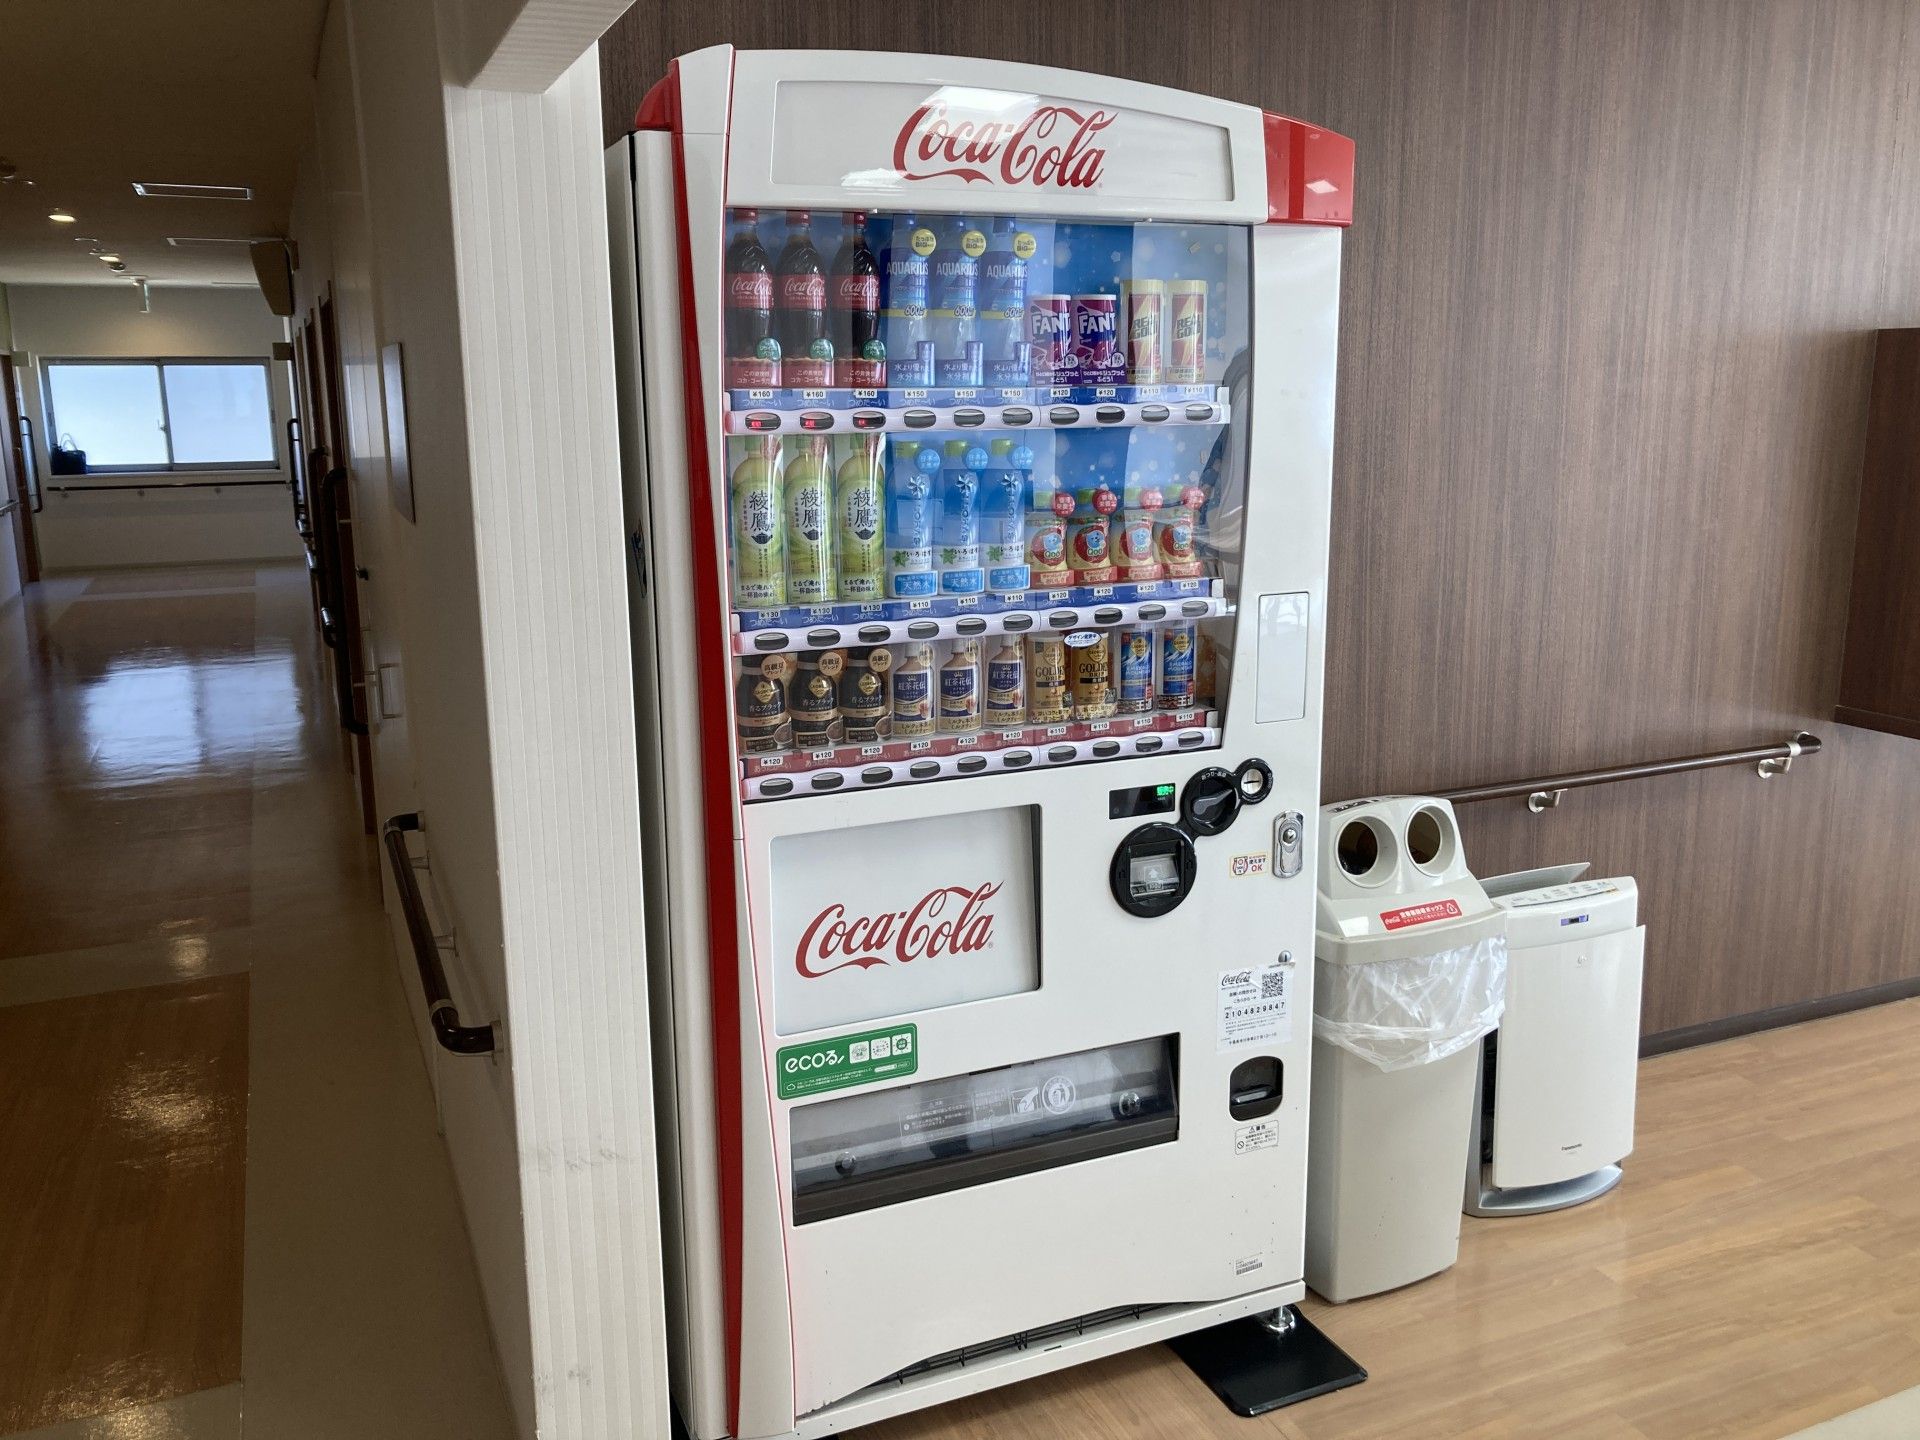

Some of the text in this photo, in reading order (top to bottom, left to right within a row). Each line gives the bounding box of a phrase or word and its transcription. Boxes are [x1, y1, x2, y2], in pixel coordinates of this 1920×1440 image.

[893, 100, 1119, 188] Coca-Cola
[886, 262, 928, 275] AQUARIUS
[936, 262, 979, 276] AQUARIUS
[987, 264, 1028, 277] AQUARIUS
[1032, 313, 1070, 334] FANT
[1078, 313, 1115, 334] FANT
[752, 390, 771, 398] ¥160
[858, 390, 876, 398] ¥160
[1052, 388, 1069, 396] ¥120
[1098, 388, 1114, 396] ¥120
[749, 489, 771, 532] 綾鷹
[800, 487, 820, 528] 綾鷹
[853, 487, 874, 528] 綾鷹
[1088, 548, 1103, 556] Qoo
[1174, 542, 1189, 550] Qoo
[1044, 551, 1060, 559] Qoo
[1251, 864, 1263, 872] OK
[795, 880, 1004, 979] Coca-Cola
[1221, 971, 1252, 986] Coca-Cola
